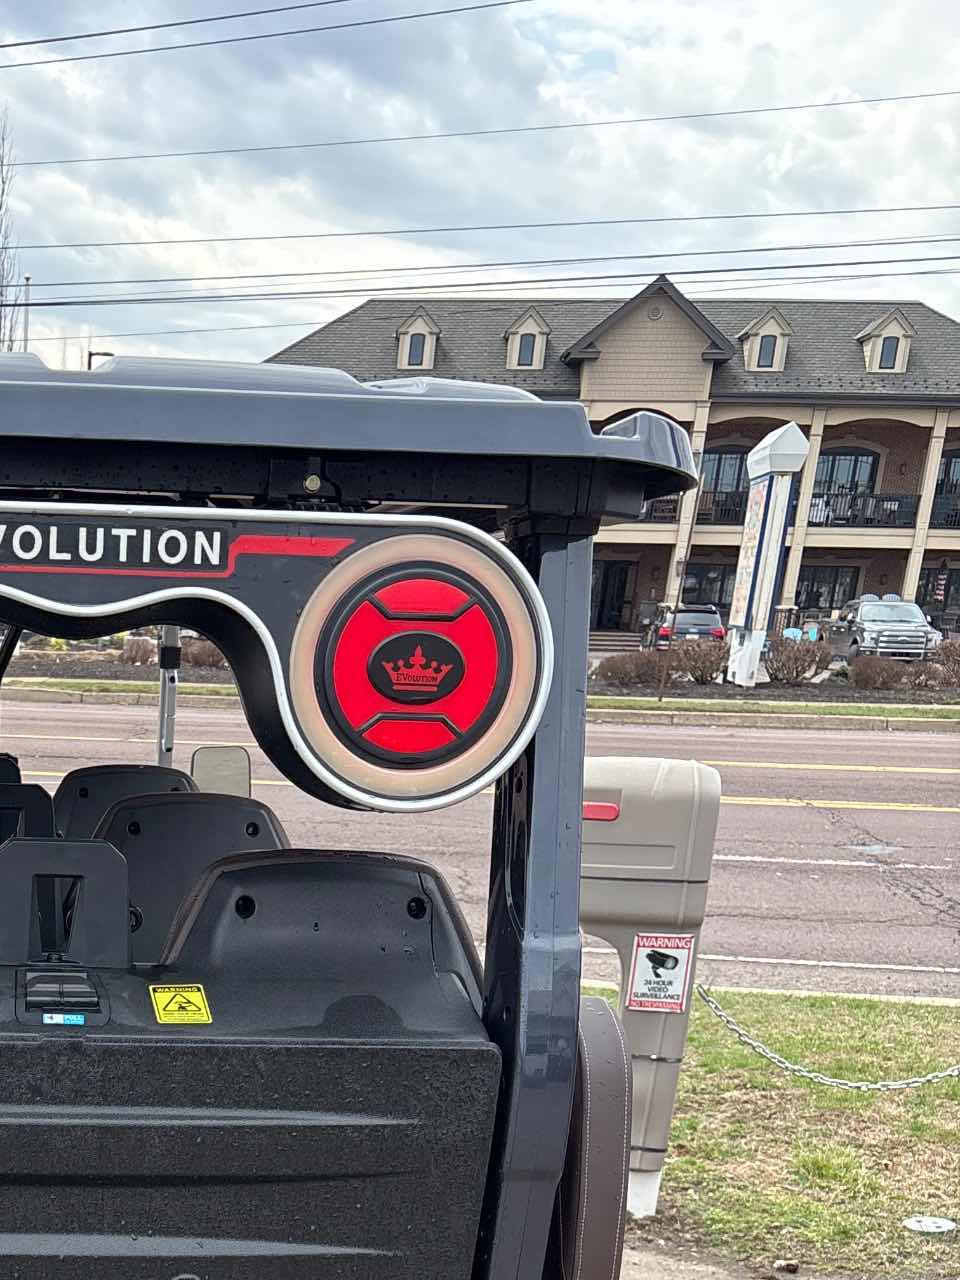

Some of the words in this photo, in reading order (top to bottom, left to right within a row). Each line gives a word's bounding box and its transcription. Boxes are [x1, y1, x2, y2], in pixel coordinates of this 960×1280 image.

[396, 673, 438, 683] EVOLUTION
[638, 937, 691, 948] WARNING
[633, 992, 680, 1000] SURVEILLANCE
